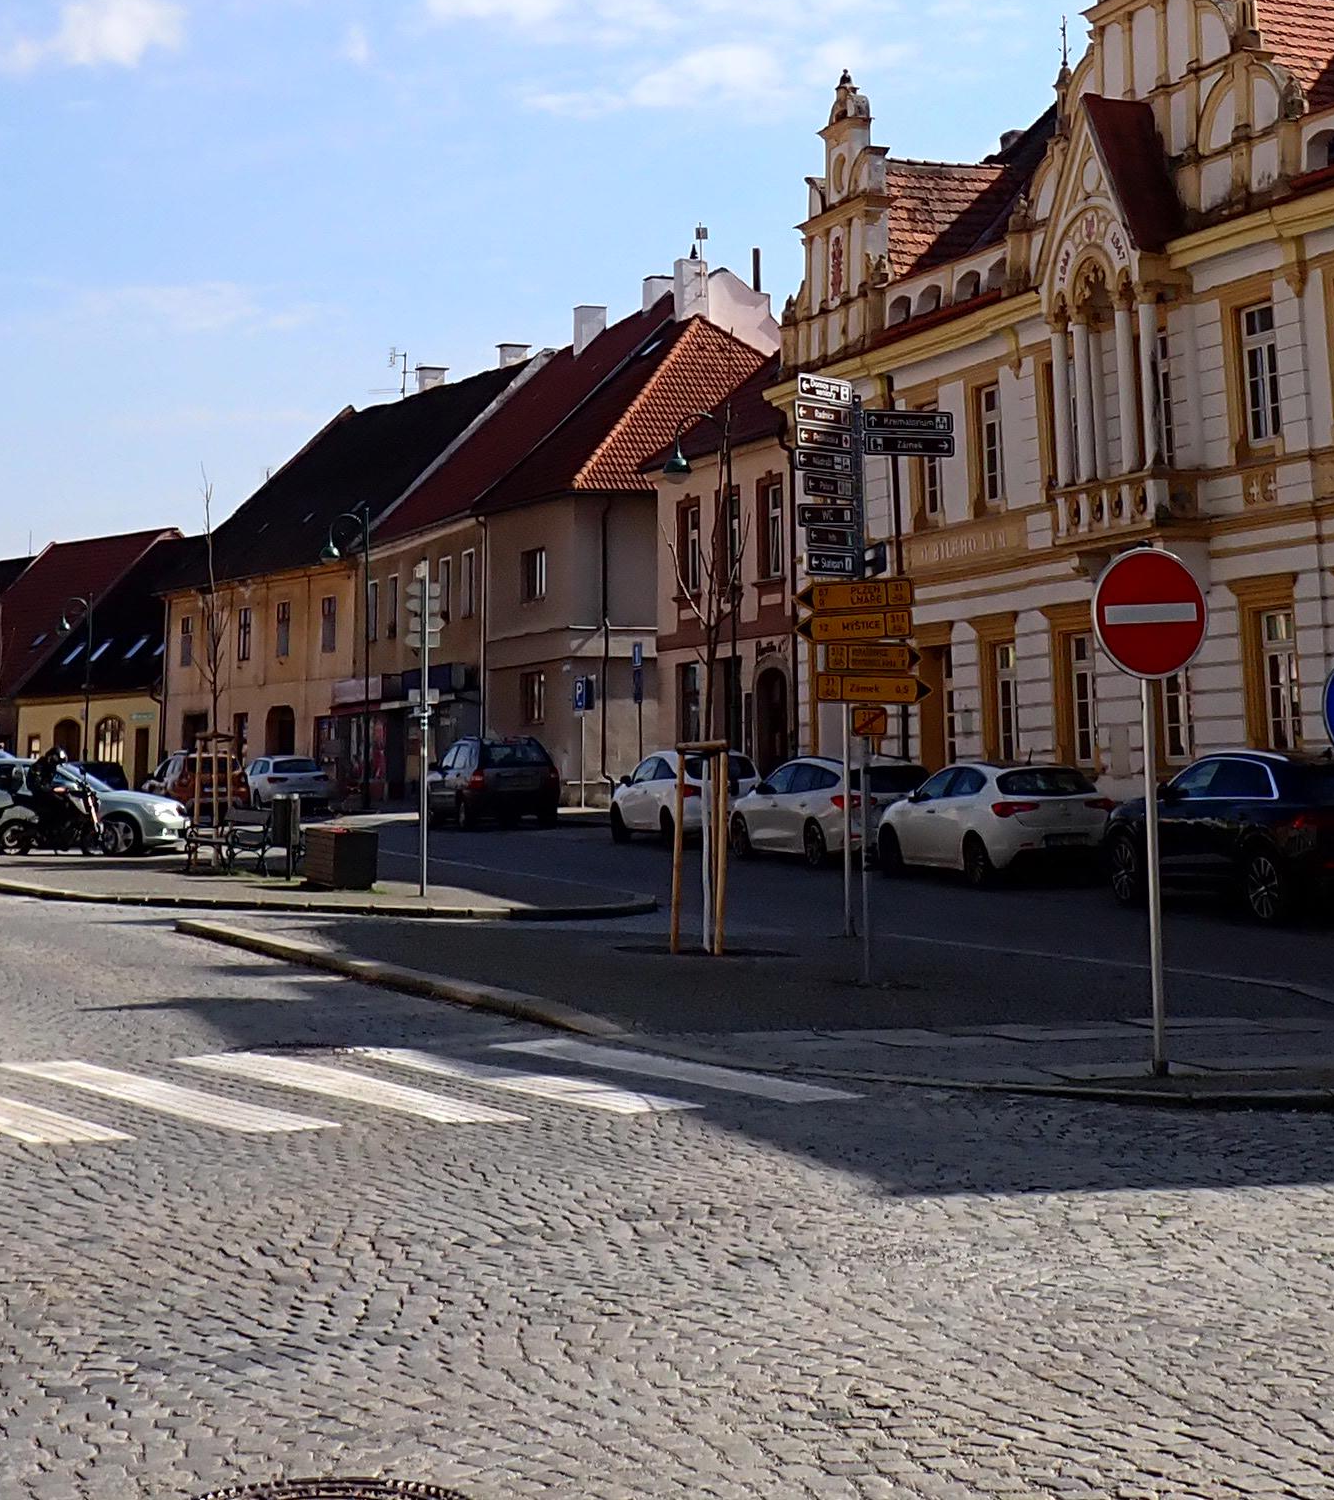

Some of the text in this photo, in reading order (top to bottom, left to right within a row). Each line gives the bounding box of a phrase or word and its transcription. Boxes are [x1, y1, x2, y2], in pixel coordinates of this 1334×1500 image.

[897, 440, 923, 450] Zámek
[821, 509, 834, 521] WC
[576, 681, 583, 701] P
[849, 684, 880, 693] Zámek
